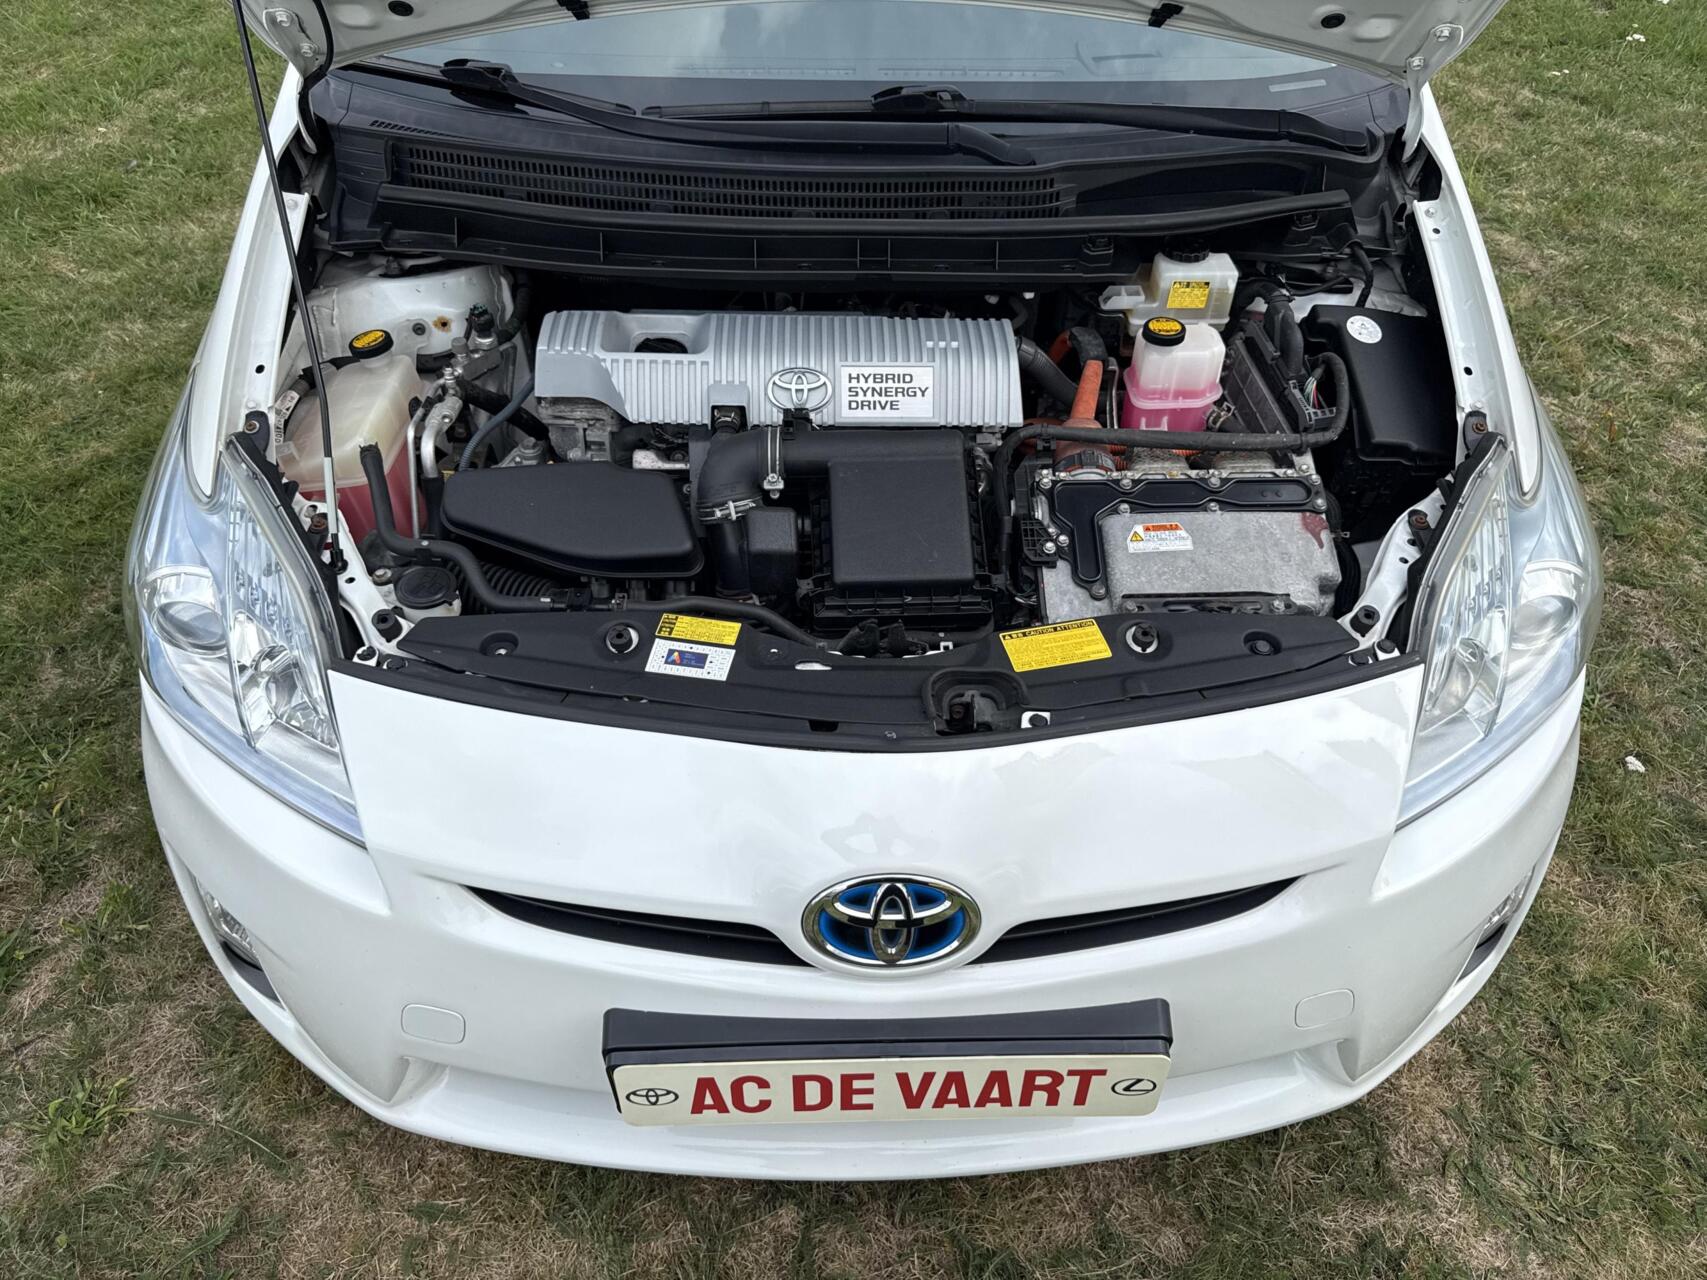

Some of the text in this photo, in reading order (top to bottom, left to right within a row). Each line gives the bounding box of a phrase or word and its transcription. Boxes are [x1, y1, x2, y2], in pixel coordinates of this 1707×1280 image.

[848, 373, 914, 384] HYBRID
[848, 386, 929, 398] SYNERGY
[848, 400, 900, 410] DRIVE
[1025, 627, 1055, 637] CAUTION
[1056, 621, 1094, 632] ATTENTION
[691, 1069, 1107, 1114] AC DE VAART
